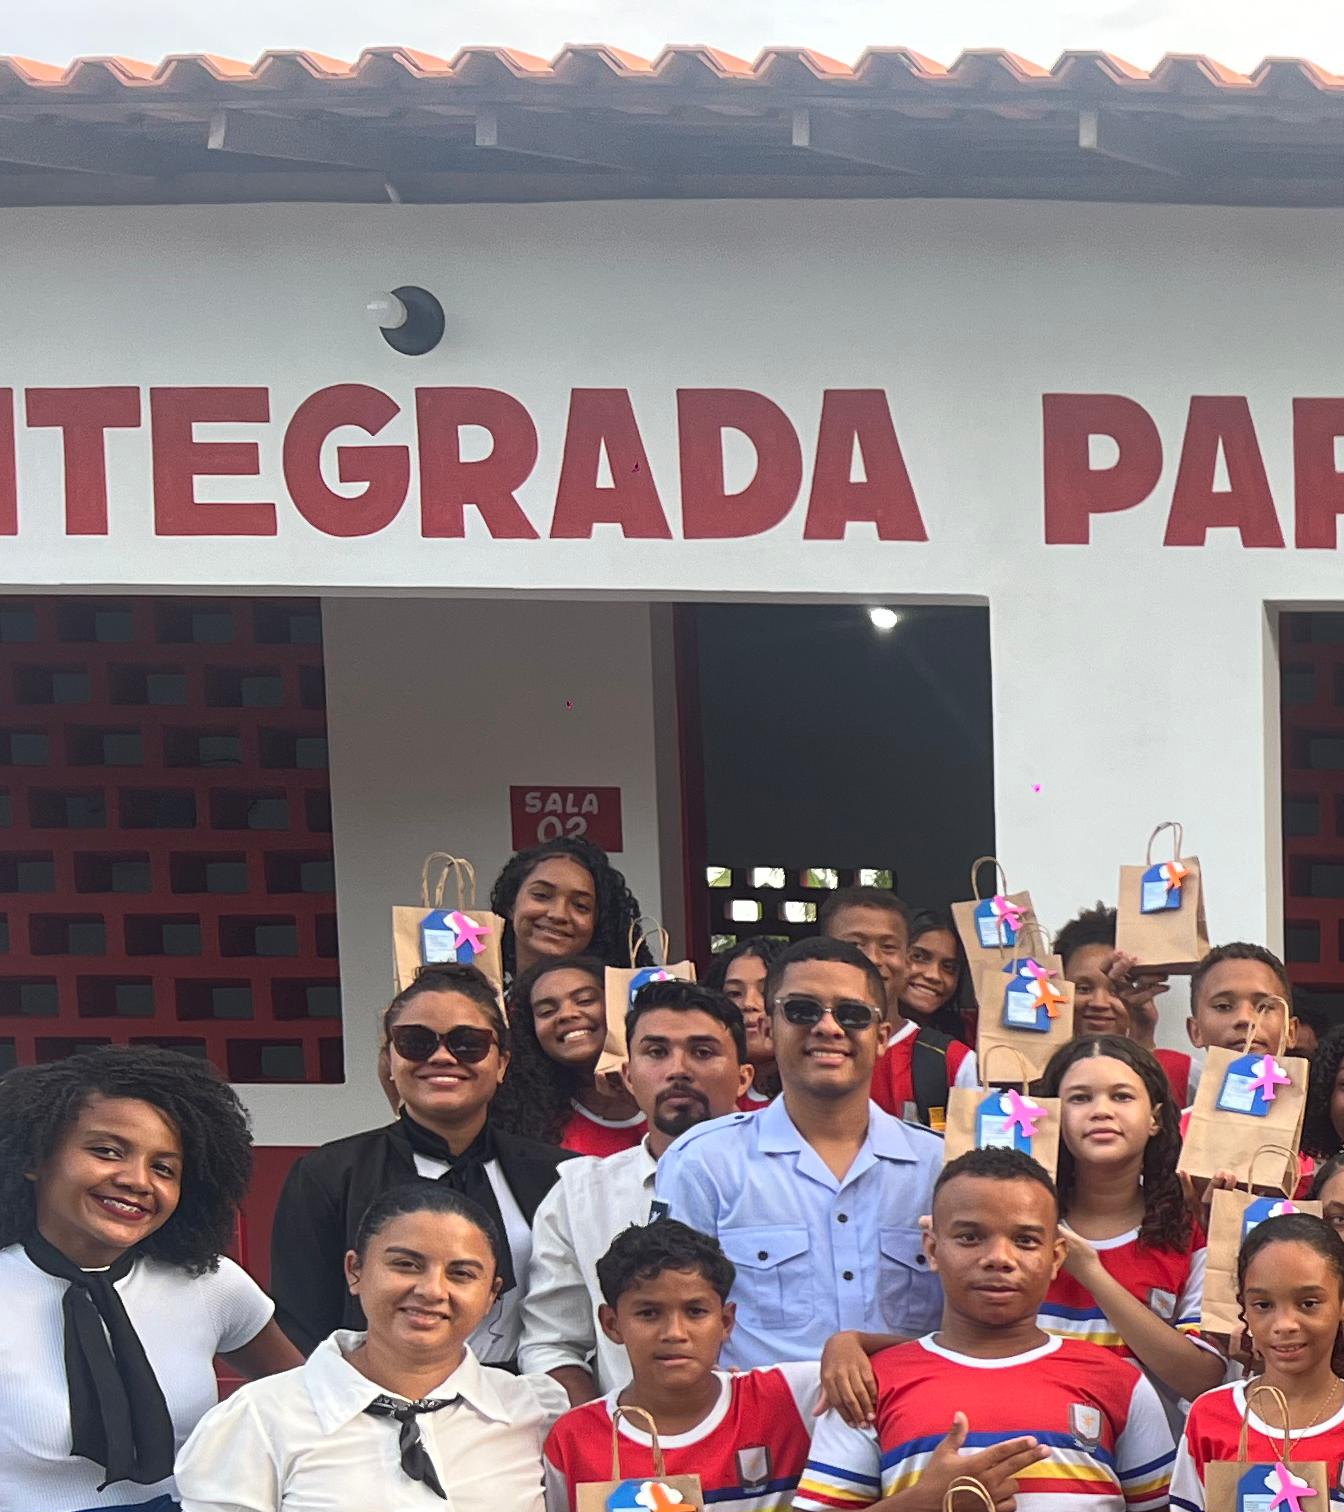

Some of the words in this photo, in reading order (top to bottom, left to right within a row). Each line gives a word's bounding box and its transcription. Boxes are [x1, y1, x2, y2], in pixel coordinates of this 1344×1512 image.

[0, 384, 928, 542] TEGRADA
[524, 791, 599, 815] SALA
[537, 815, 588, 843] 02
